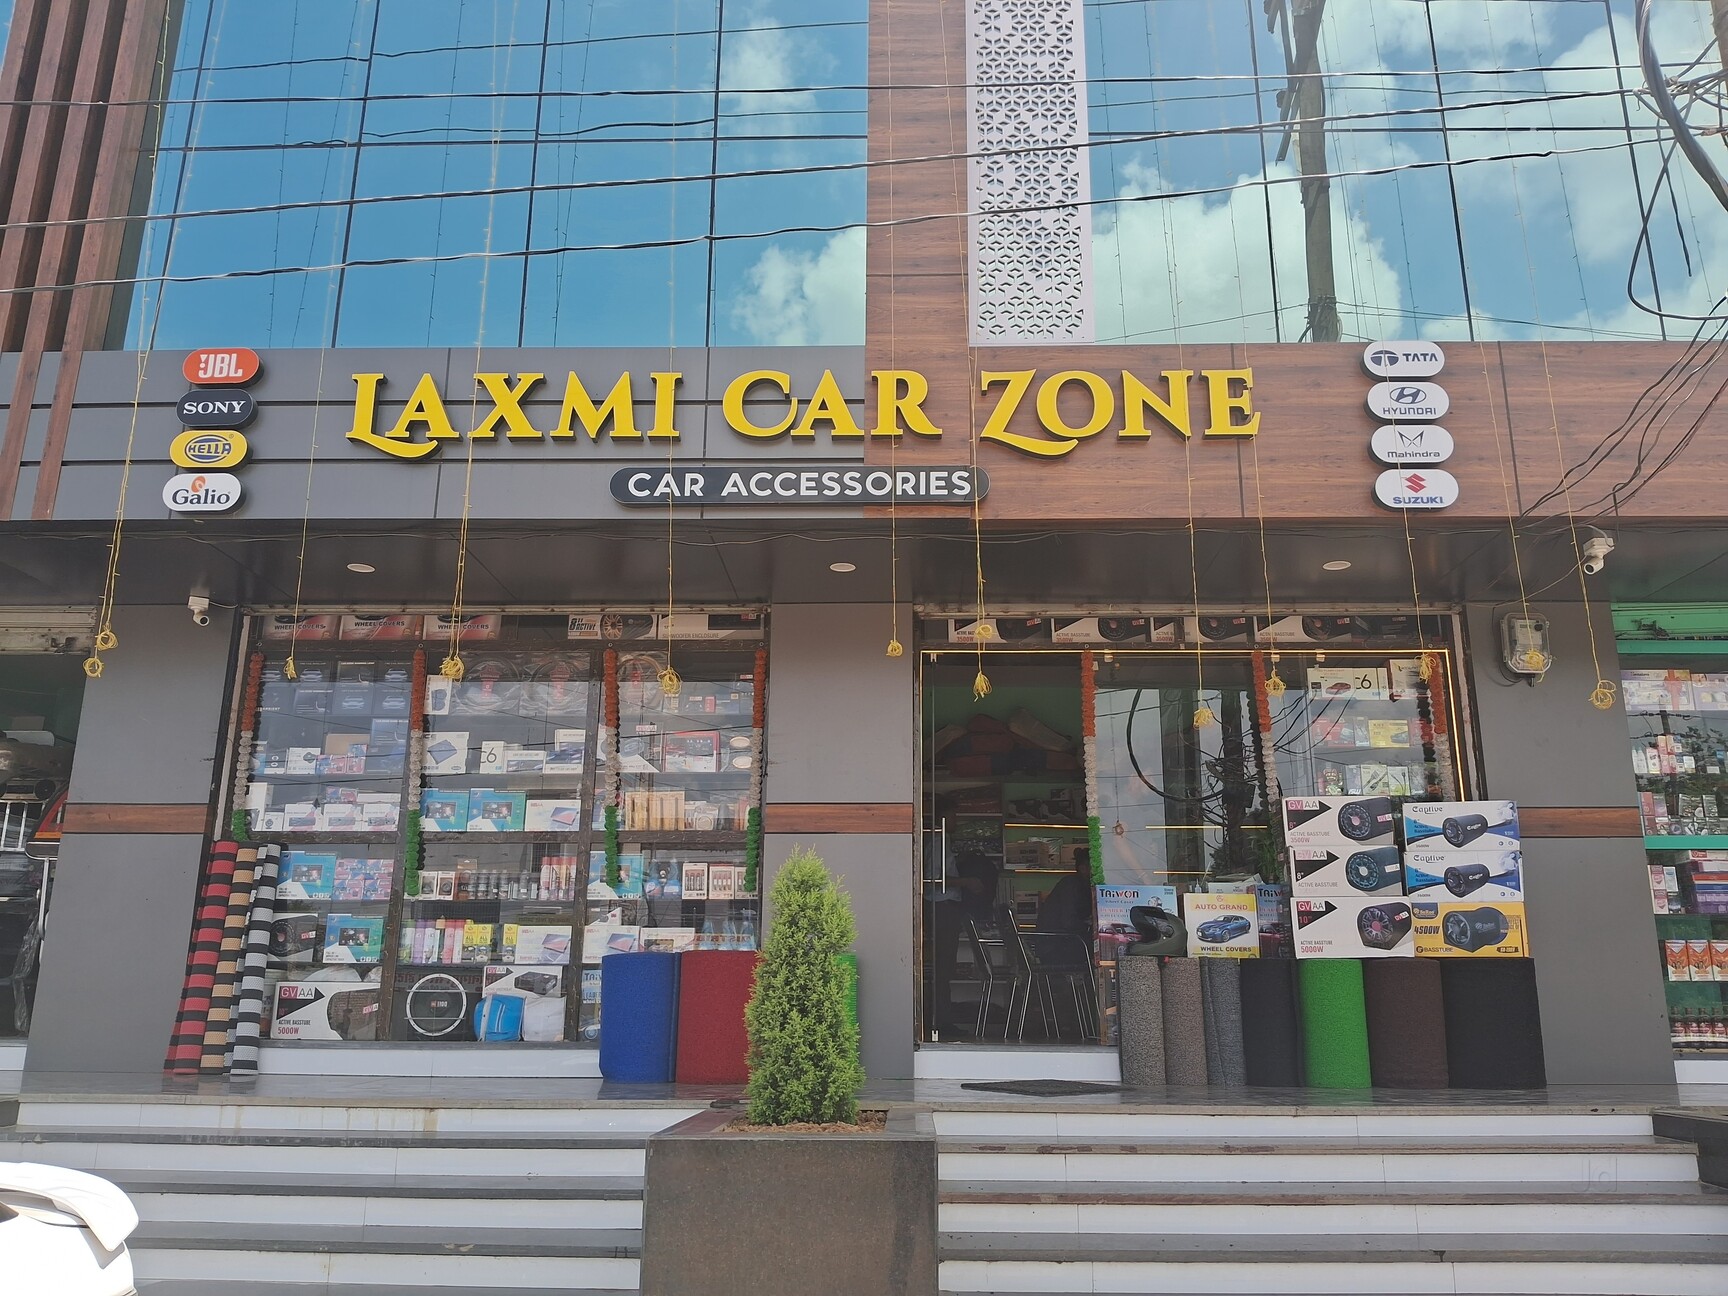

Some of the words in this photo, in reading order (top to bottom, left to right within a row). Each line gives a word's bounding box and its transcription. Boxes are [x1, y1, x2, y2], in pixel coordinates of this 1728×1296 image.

[1402, 352, 1438, 362] TATA
[198, 353, 243, 378] JBL
[183, 401, 246, 414] SONY
[346, 370, 684, 458] LAXMI
[722, 368, 943, 438] CAR
[980, 367, 1261, 455] ZONE
[1382, 407, 1436, 416] HYUNDAI
[187, 442, 232, 456] HELLA
[1387, 450, 1440, 458] Mahindra
[627, 472, 705, 497] CAR
[720, 471, 971, 497] ACCESSORIES
[172, 488, 231, 505] Galio
[1392, 496, 1443, 504] SUZUKI
[1298, 901, 1324, 910] GVAA
[1414, 926, 1440, 934] 4500W
[281, 987, 314, 998] GVAA
[278, 1026, 299, 1034] 5000W
